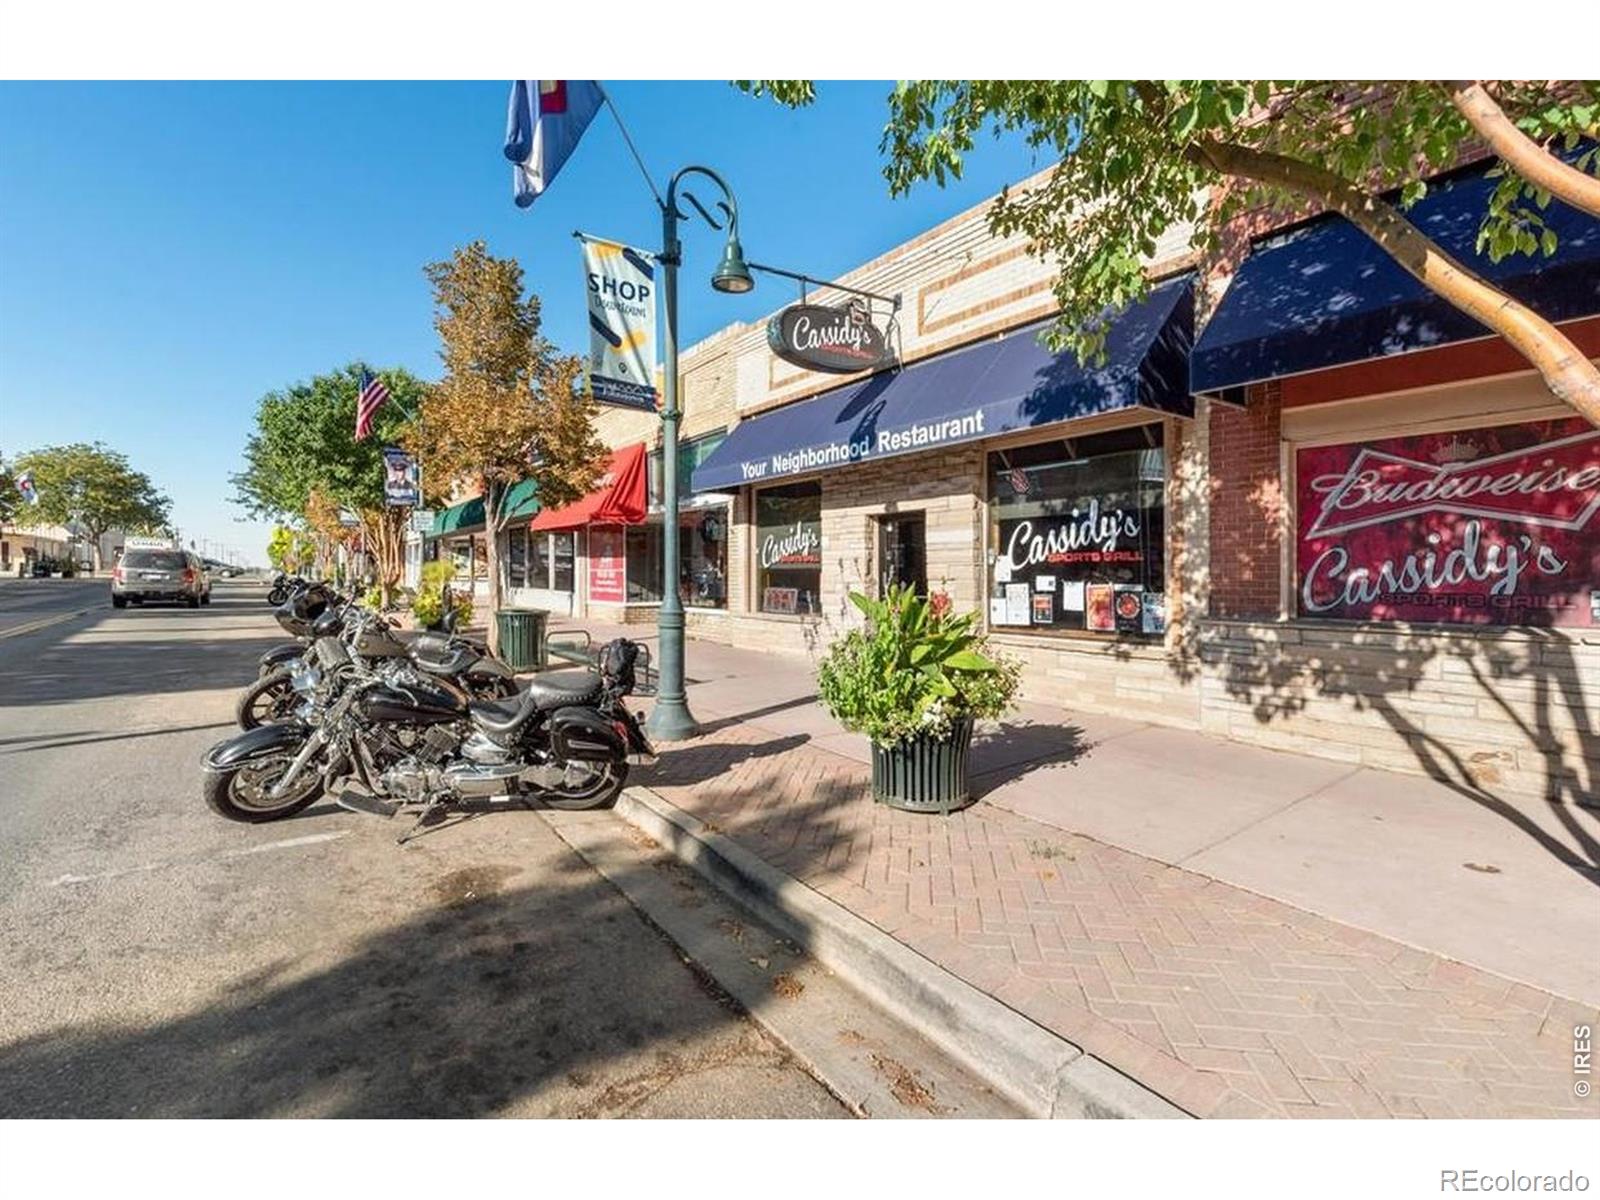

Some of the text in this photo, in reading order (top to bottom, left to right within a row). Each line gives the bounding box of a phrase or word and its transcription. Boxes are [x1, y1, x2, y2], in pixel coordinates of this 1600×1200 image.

[588, 272, 650, 303] SHOP
[793, 315, 872, 353] Cassidy's
[741, 409, 985, 480] Your Neighborhood Restaurant
[761, 520, 819, 569] Cassidy's
[1007, 499, 1141, 572] Cassidy's
[1303, 519, 1568, 612] Cassidy's
